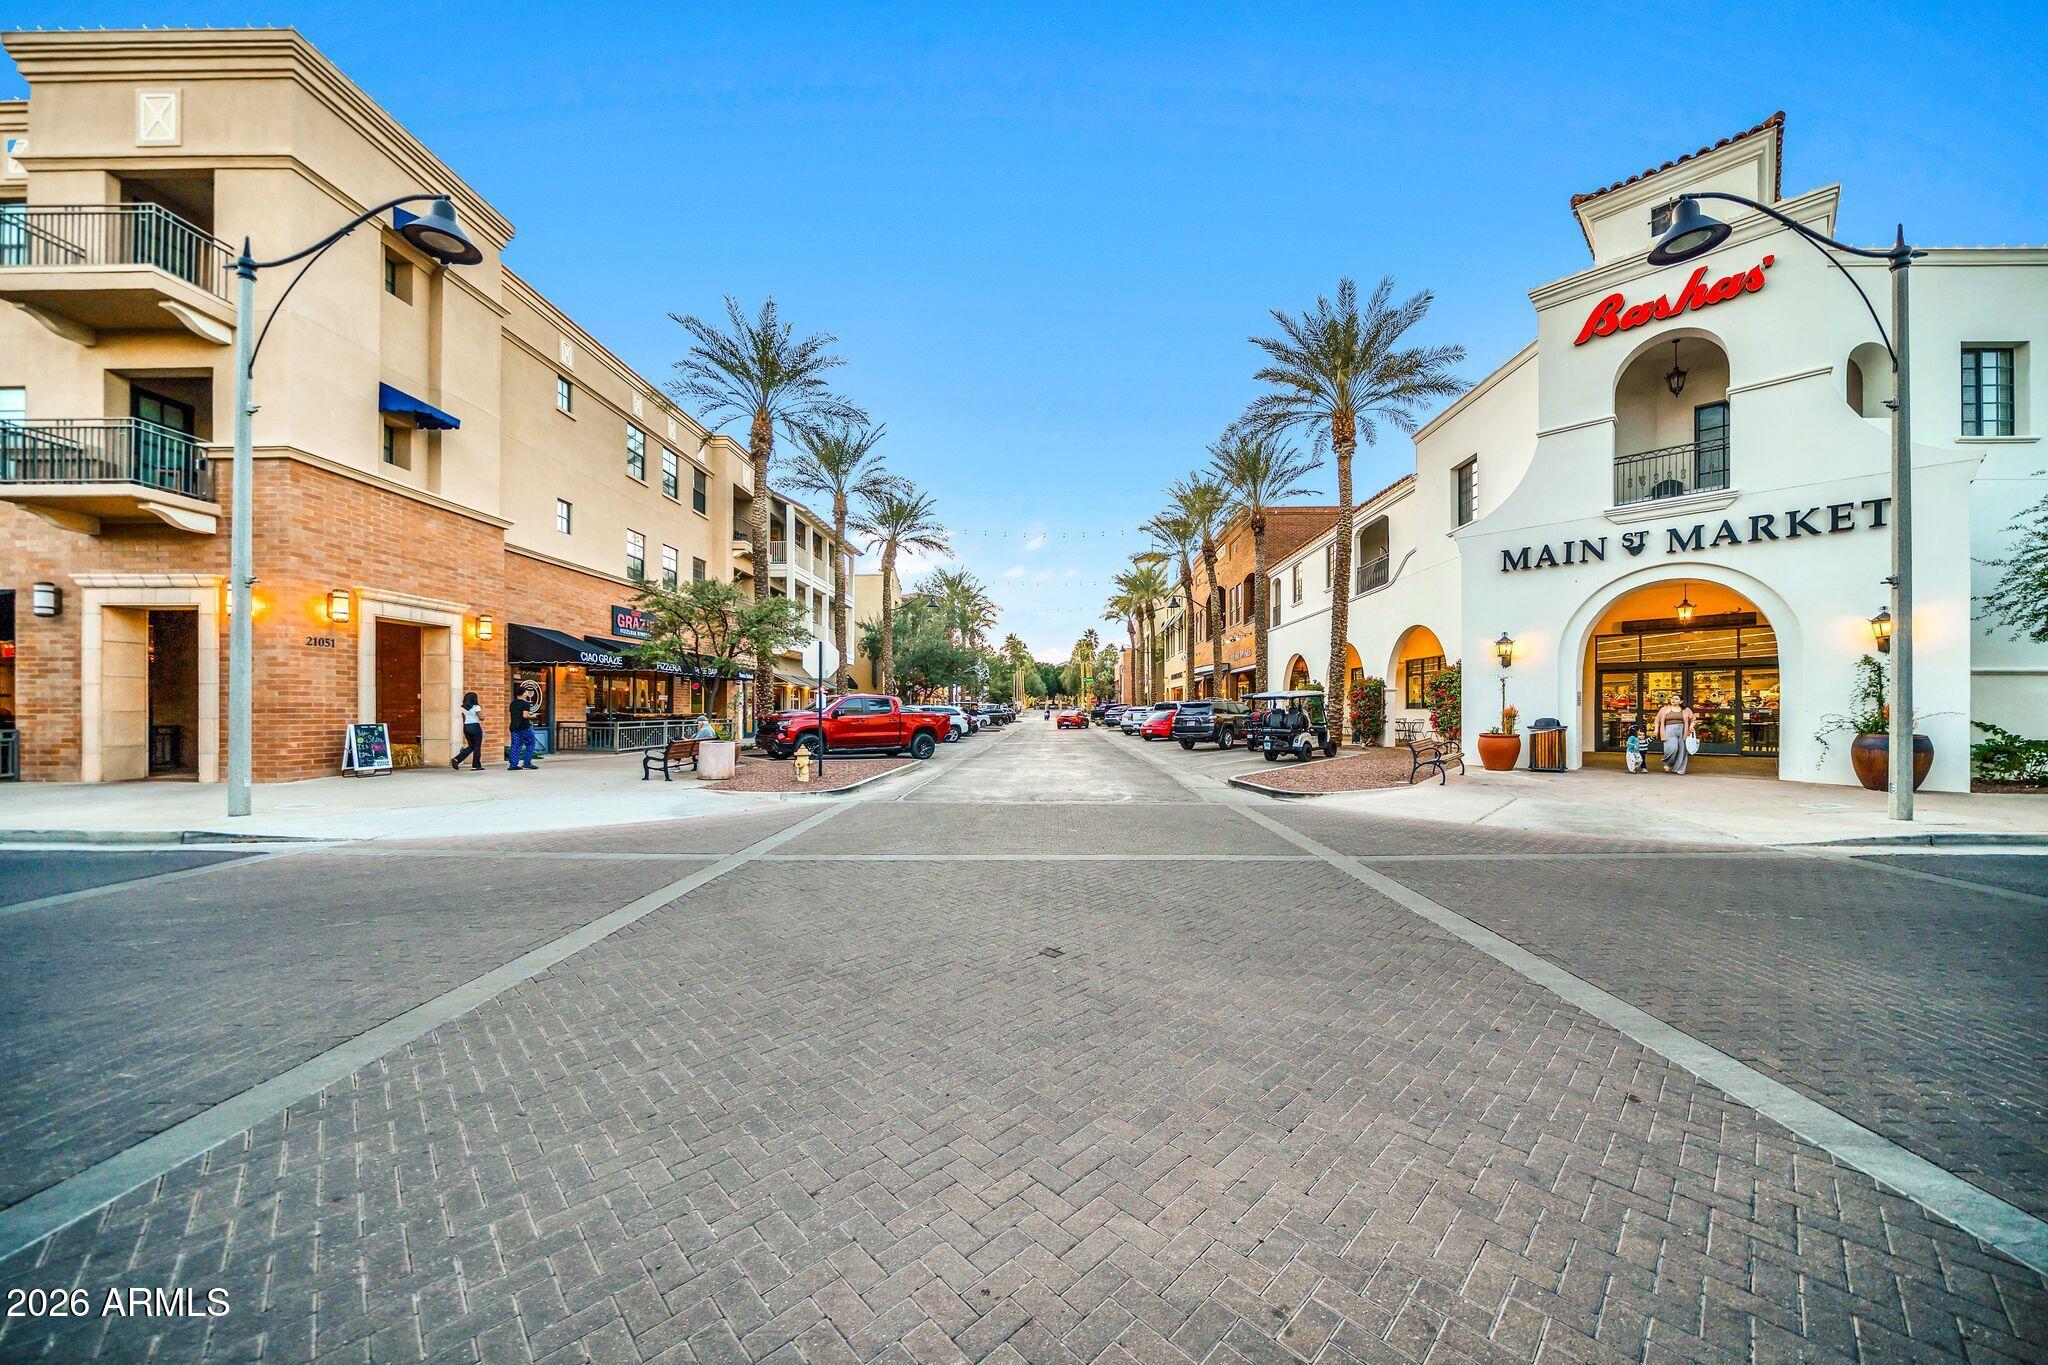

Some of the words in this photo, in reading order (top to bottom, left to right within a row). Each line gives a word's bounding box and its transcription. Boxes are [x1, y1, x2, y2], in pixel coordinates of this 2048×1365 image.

[1574, 254, 1775, 346] Bashas'
[1500, 536, 1608, 574] MAIN
[1621, 530, 1650, 549] ST
[1666, 497, 1892, 554] MARKET
[617, 612, 652, 632] GRAZ
[306, 636, 336, 648] 21051
[580, 651, 598, 663] CIAO
[598, 654, 623, 666] GRAZIE
[656, 661, 683, 673] PIZZERIA
